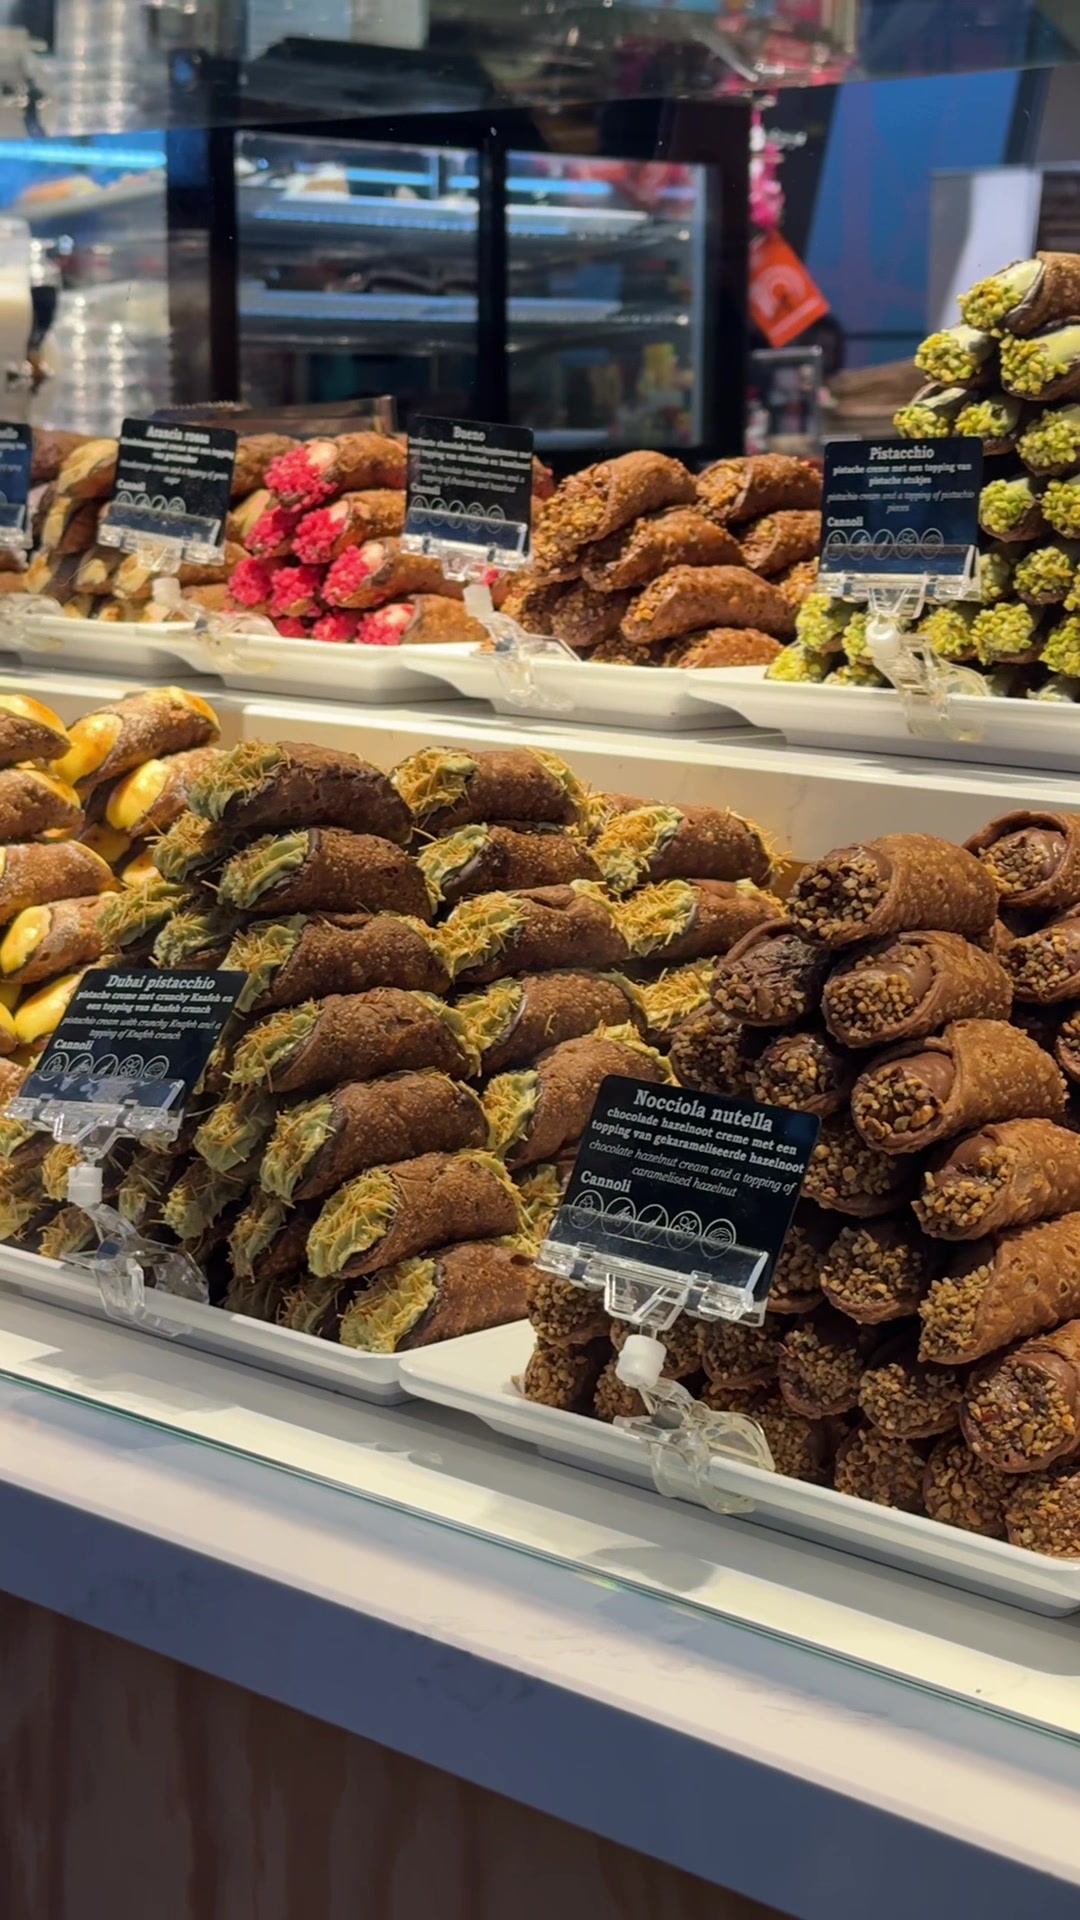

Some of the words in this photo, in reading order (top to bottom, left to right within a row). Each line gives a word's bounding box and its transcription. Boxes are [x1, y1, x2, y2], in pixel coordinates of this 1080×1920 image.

[454, 426, 485, 441] Bueno
[870, 446, 934, 460] Pistacchio
[828, 517, 863, 527] Cannoli
[105, 975, 144, 987] Dubai
[146, 976, 216, 991] pistacchio
[54, 1039, 94, 1050] Cannoli
[634, 1090, 706, 1118] Nocciola
[711, 1109, 772, 1132] nutella
[608, 1108, 658, 1126] chocolade
[662, 1118, 713, 1137] hazelnoot
[716, 1132, 749, 1144] creme
[752, 1139, 774, 1150] met
[777, 1144, 796, 1155] een
[592, 1120, 631, 1139] topping
[634, 1131, 652, 1140] van
[654, 1135, 746, 1160] gekarameliseerde
[750, 1152, 804, 1173] hazelnoot
[590, 1140, 633, 1156] chocolate
[635, 1150, 678, 1166] hazelnut
[679, 1162, 709, 1173] cream
[711, 1168, 733, 1178] and
[743, 1174, 782, 1192] topping
[783, 1183, 797, 1195] of
[581, 1171, 631, 1192] Cannoli
[632, 1168, 692, 1186] caramelised
[693, 1178, 737, 1196] hazelnut
